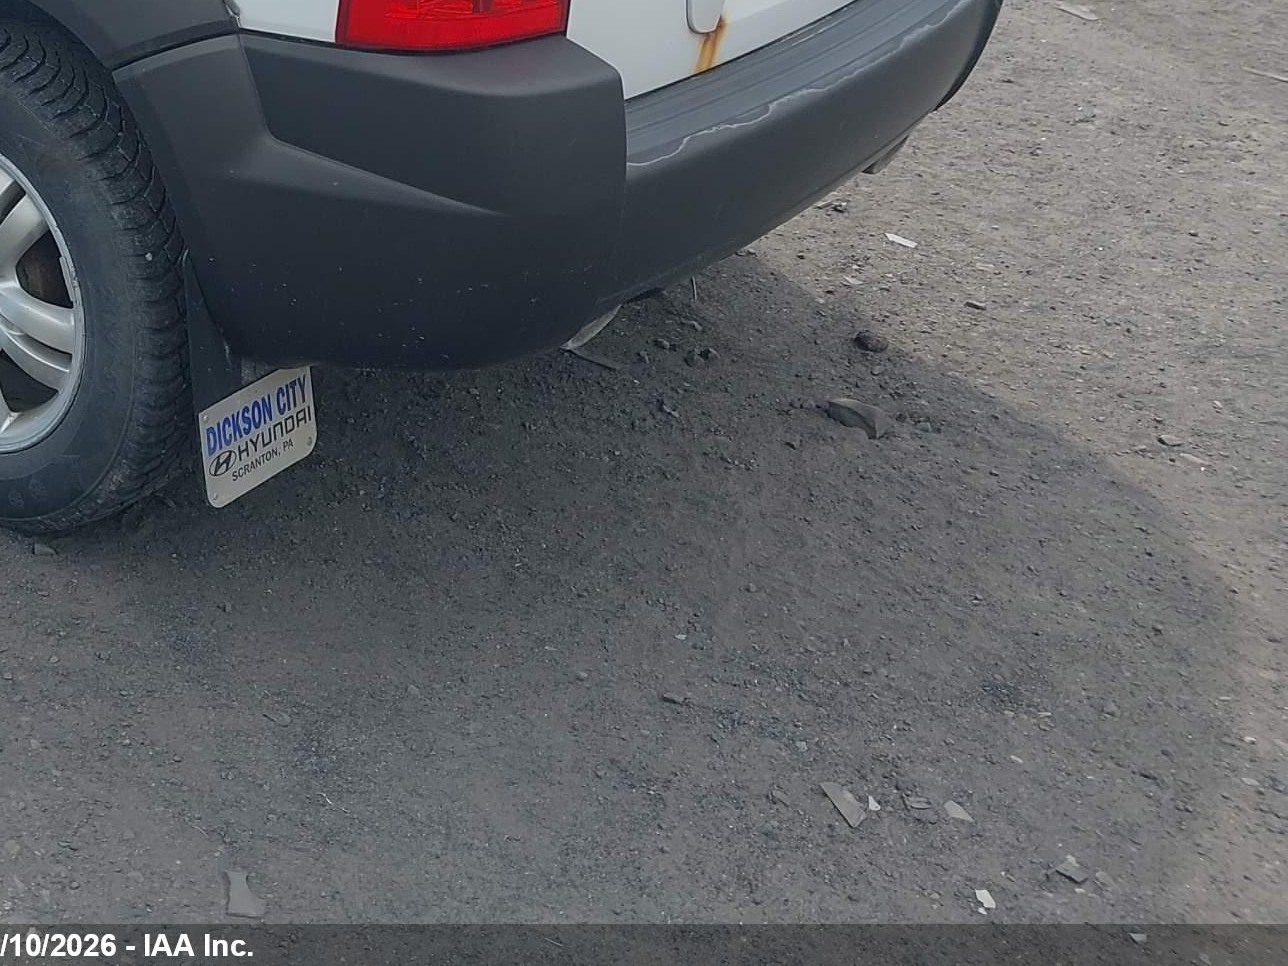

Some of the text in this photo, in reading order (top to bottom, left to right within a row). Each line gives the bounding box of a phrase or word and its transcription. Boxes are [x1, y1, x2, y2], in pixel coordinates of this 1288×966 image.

[206, 374, 307, 457] DICKSON CITY
[238, 405, 312, 462] HYUNDAI
[283, 438, 294, 452] PA
